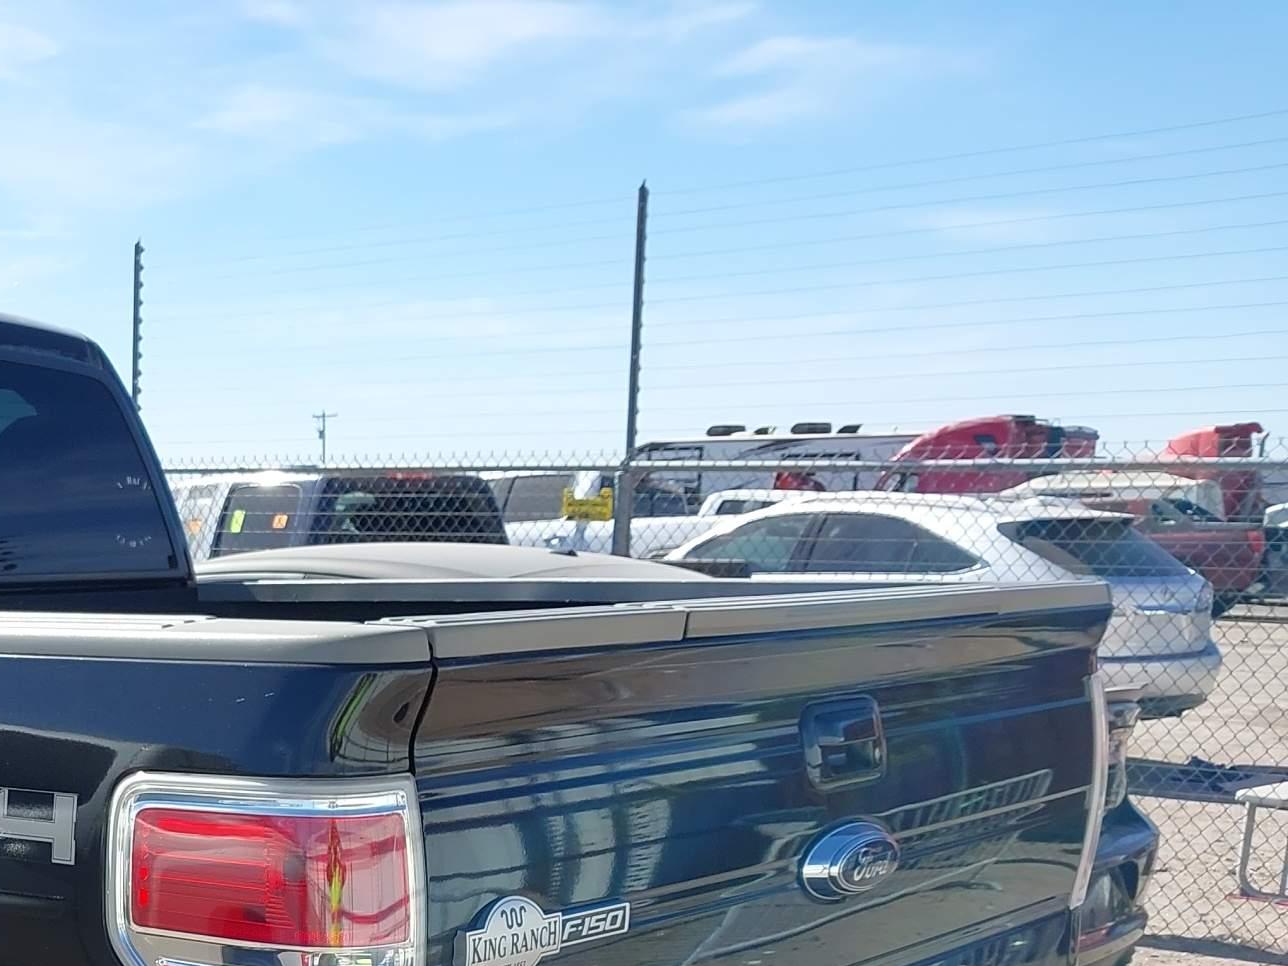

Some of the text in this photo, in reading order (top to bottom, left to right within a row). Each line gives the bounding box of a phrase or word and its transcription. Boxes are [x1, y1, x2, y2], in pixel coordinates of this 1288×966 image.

[853, 846, 898, 882] Ford
[471, 920, 558, 965] KING RANCH
